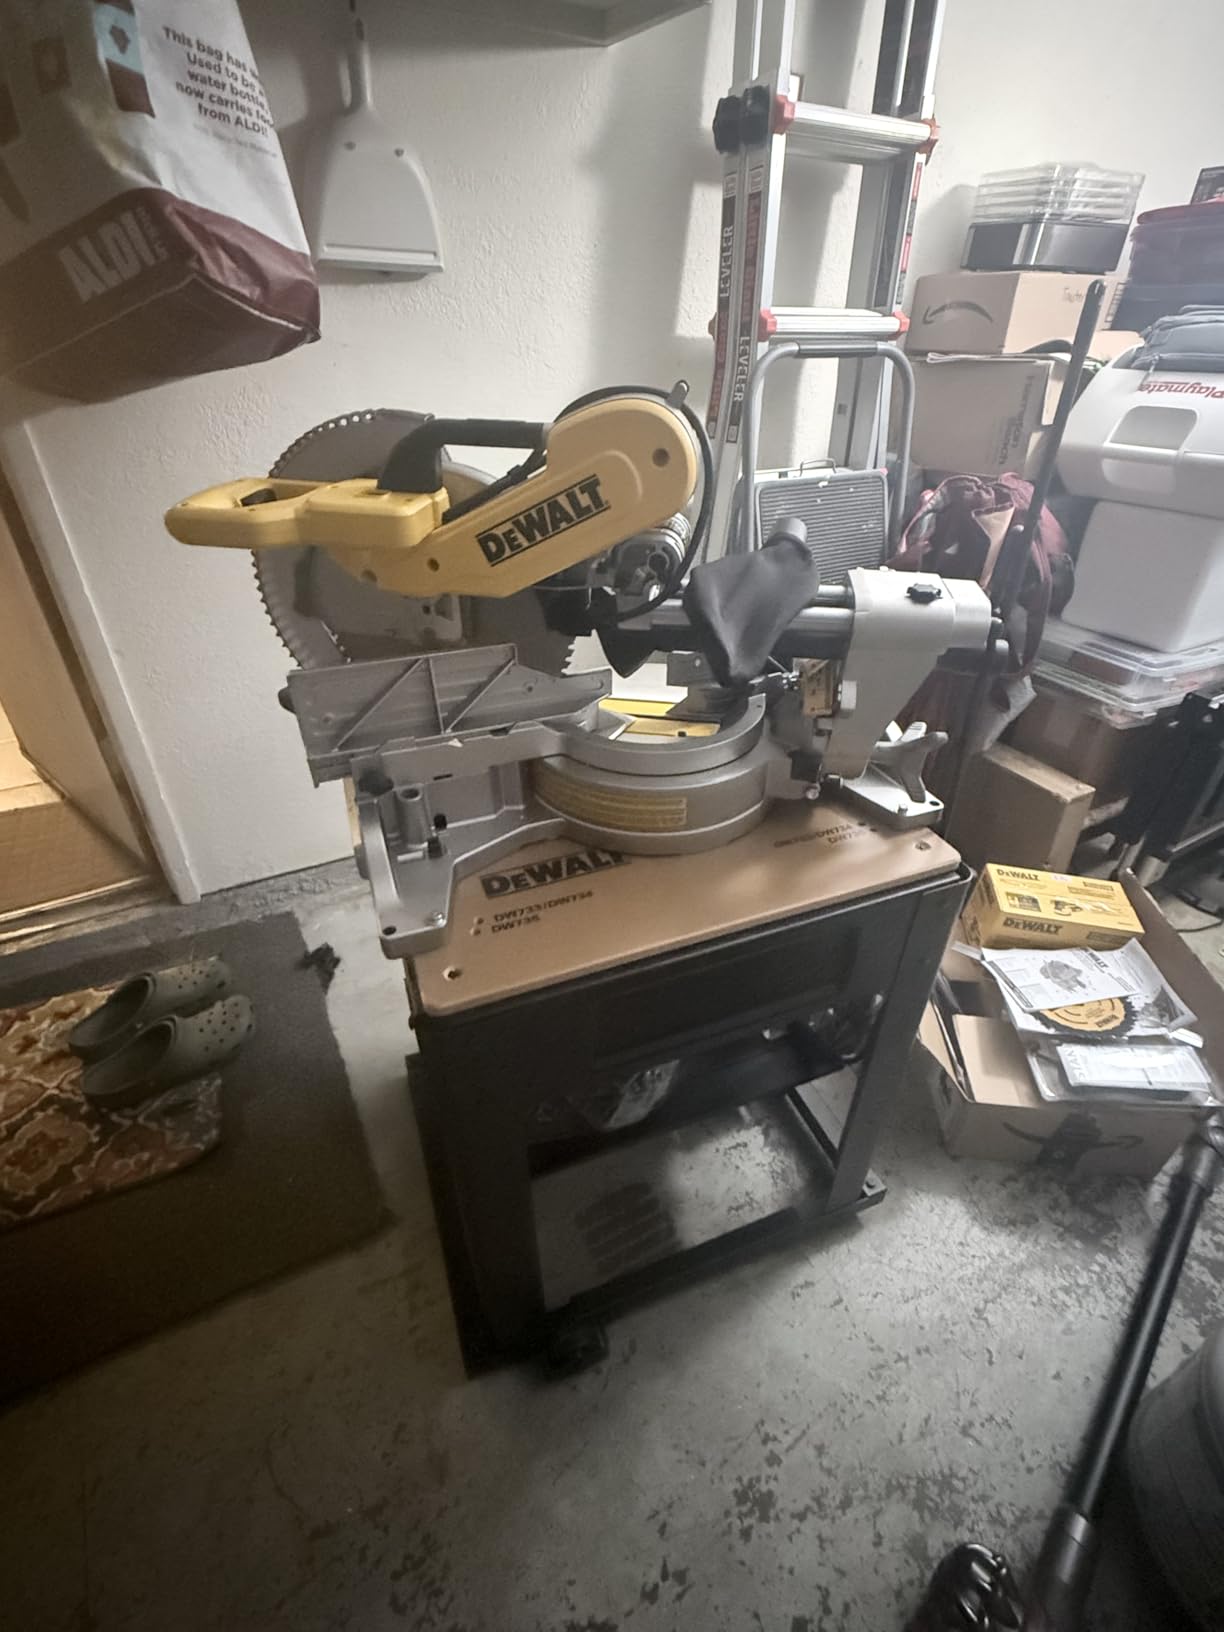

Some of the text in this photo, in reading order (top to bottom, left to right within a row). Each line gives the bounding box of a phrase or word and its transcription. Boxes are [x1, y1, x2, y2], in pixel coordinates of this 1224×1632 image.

[163, 26, 193, 48] This
[196, 40, 224, 61] bag
[186, 52, 222, 73] Used
[225, 67, 238, 81] to
[241, 75, 256, 92] be
[187, 70, 227, 91] water
[175, 81, 204, 100] now
[209, 93, 253, 117] carries
[198, 103, 231, 123] from
[720, 226, 734, 297] LEVELER
[734, 336, 750, 401] LEVELER
